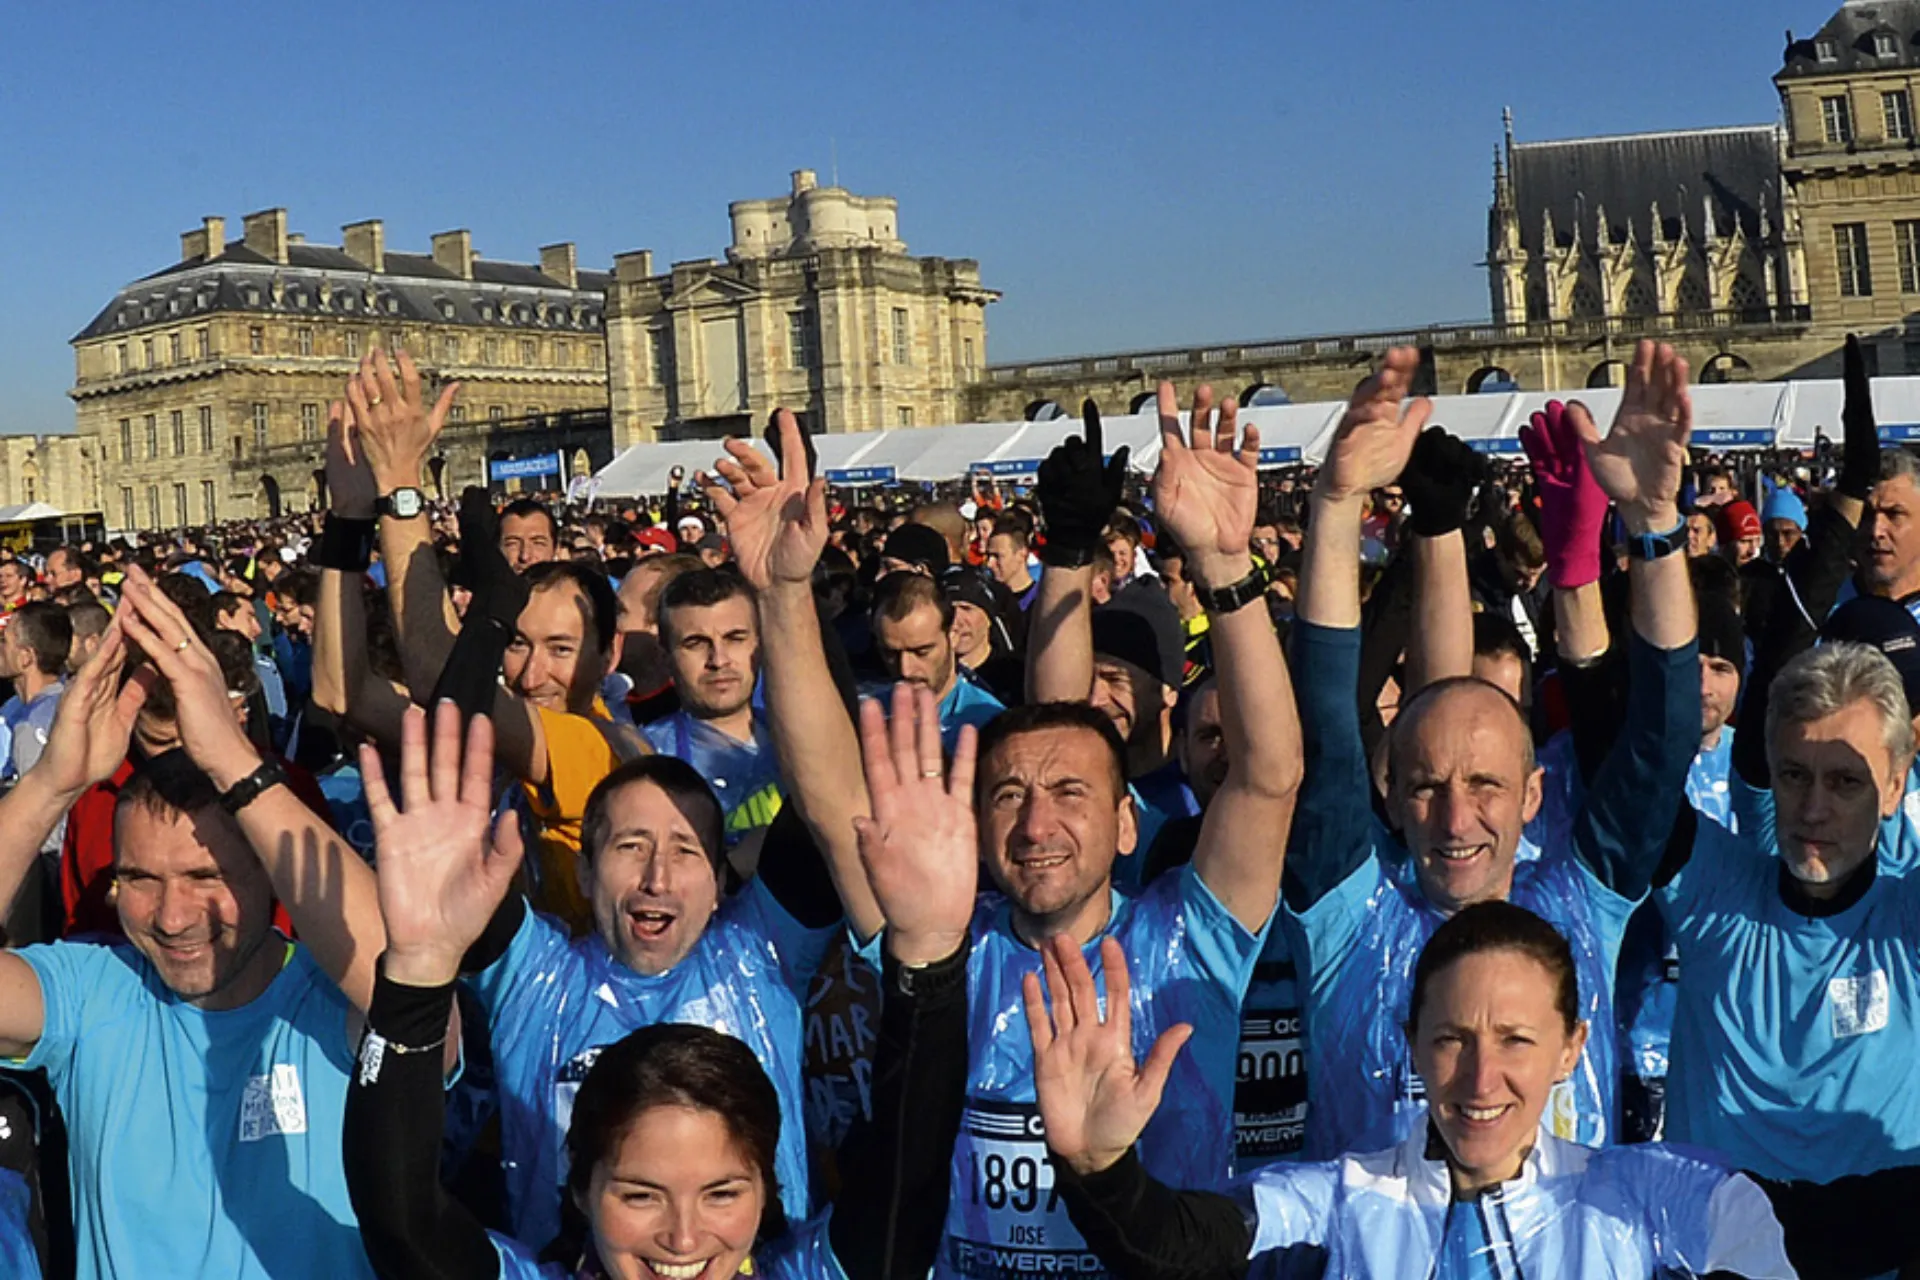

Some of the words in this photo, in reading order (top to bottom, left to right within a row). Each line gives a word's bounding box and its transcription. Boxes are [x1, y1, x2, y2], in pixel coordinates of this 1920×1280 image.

[1709, 432, 1735, 441] BOX
[1737, 432, 1746, 440] 7
[1008, 1225, 1045, 1244] JOSE
[957, 1243, 1106, 1272] POWERAD
